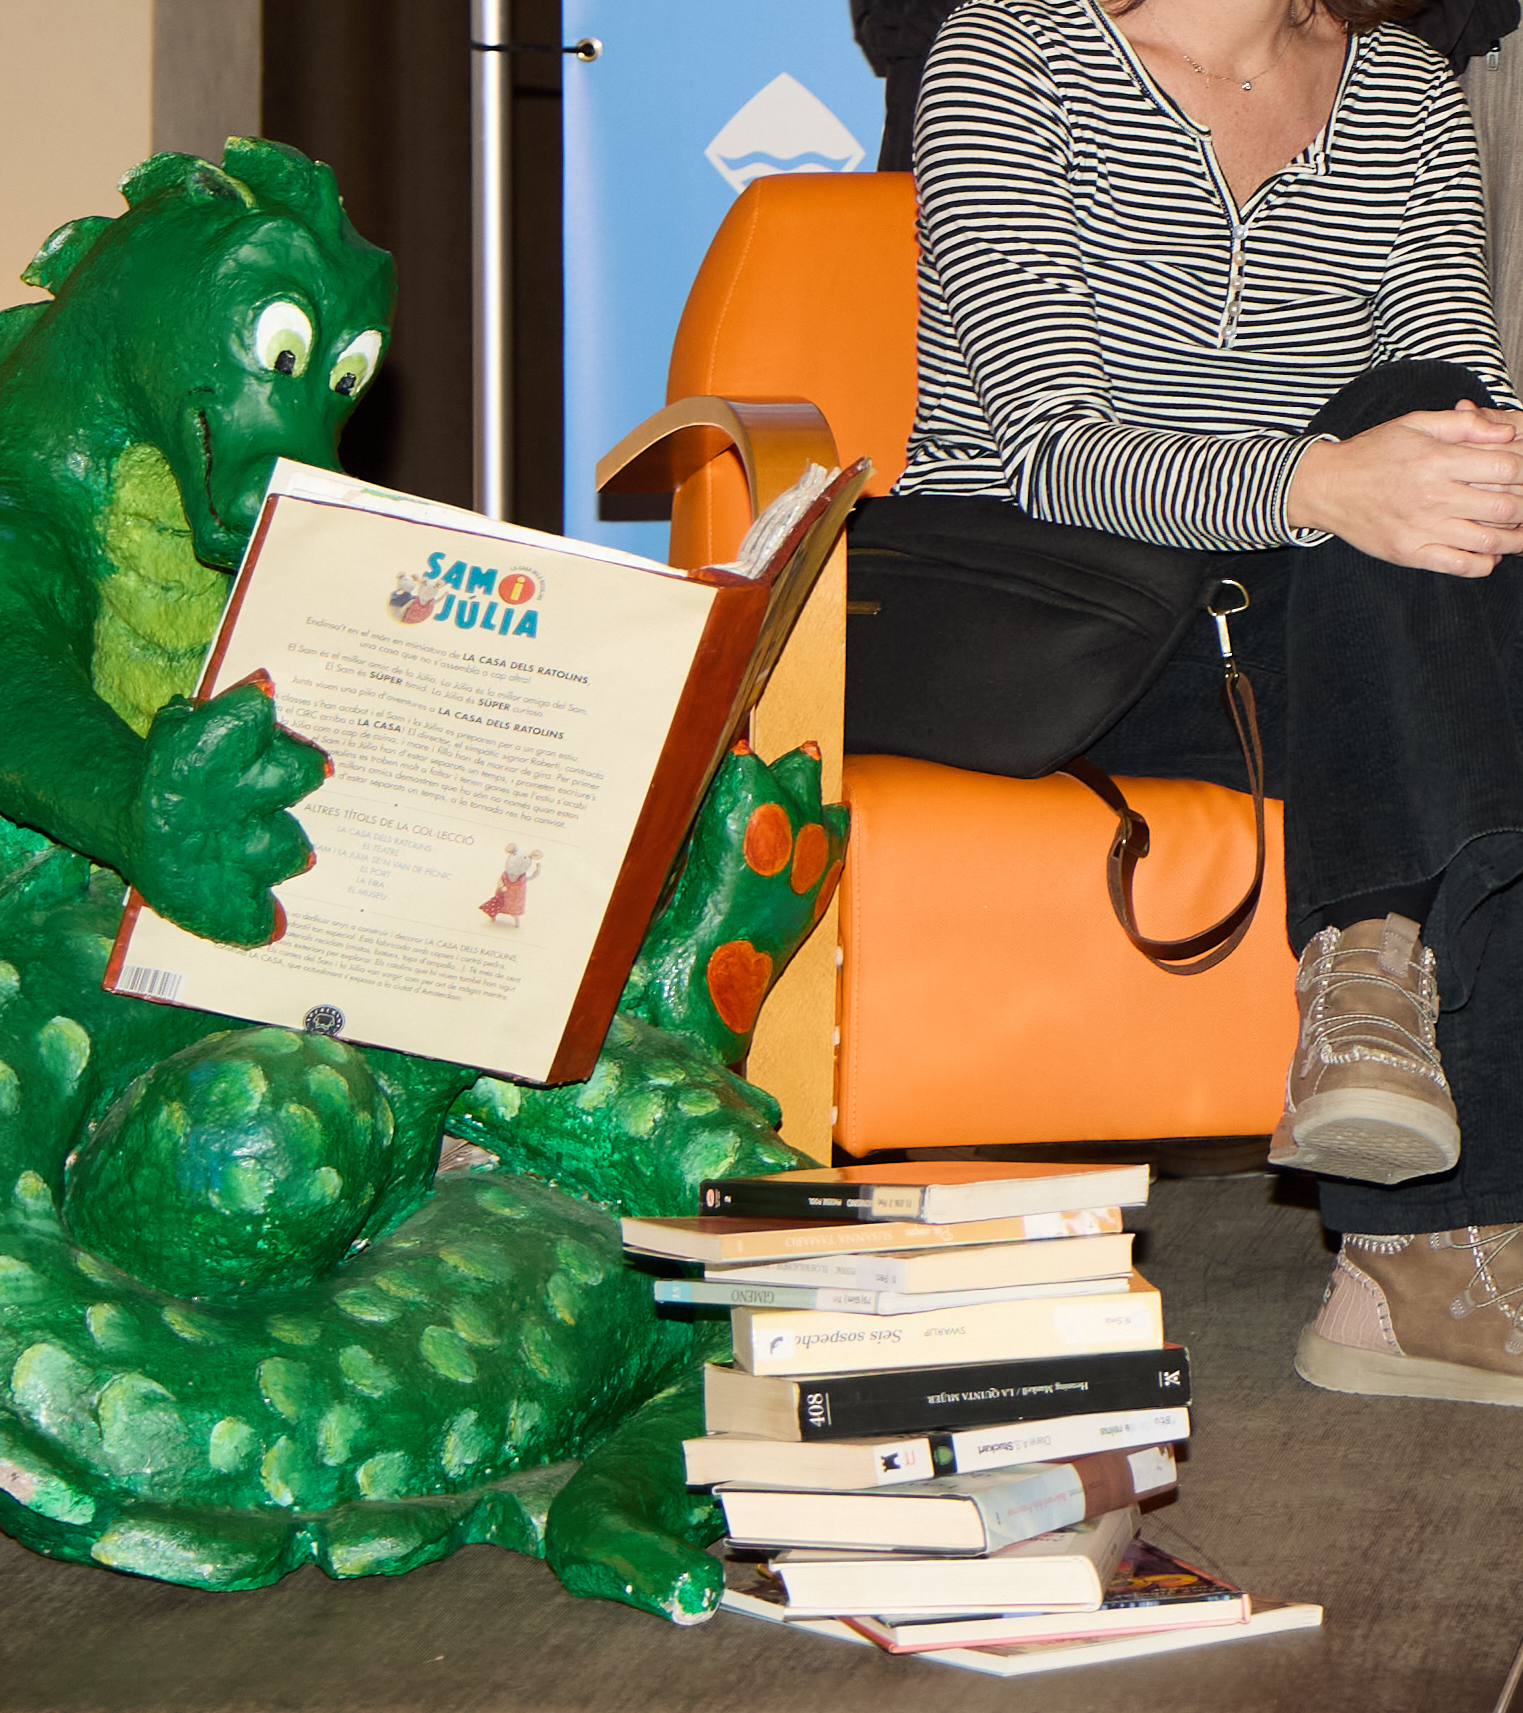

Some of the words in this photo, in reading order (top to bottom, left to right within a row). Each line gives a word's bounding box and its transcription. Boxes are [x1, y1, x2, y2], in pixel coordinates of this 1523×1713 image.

[424, 551, 498, 595] SAM
[433, 594, 539, 639] JÚLIA
[478, 655, 507, 668] CASA
[509, 661, 535, 673] DELS
[454, 711, 483, 724] CASA
[485, 718, 511, 730] DELS
[784, 1234, 837, 1248] TAMARO
[838, 1230, 893, 1246] SUSANNA
[731, 1289, 775, 1305] GIMENO
[869, 1329, 903, 1345] Seis
[927, 1391, 960, 1404] MUJER
[962, 1387, 1000, 1401] QUINTA
[1001, 1387, 1015, 1398] LA
[806, 1392, 827, 1428] 408
